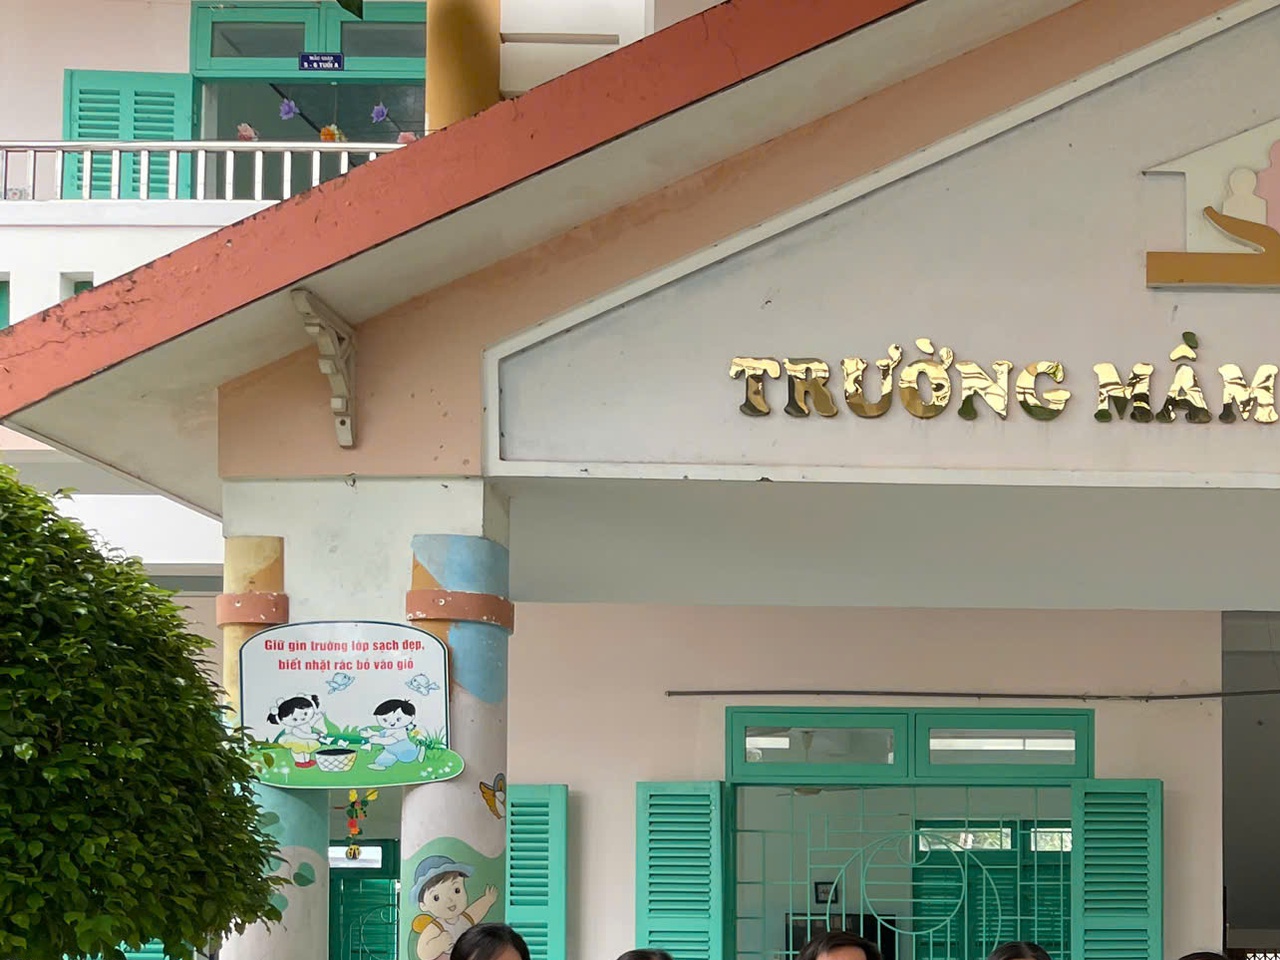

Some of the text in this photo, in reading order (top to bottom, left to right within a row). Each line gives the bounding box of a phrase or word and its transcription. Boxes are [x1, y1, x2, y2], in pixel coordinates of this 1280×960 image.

[729, 338, 1071, 421] TRƯỜNG
[373, 640, 399, 653] sạch
[278, 657, 301, 670] biết
